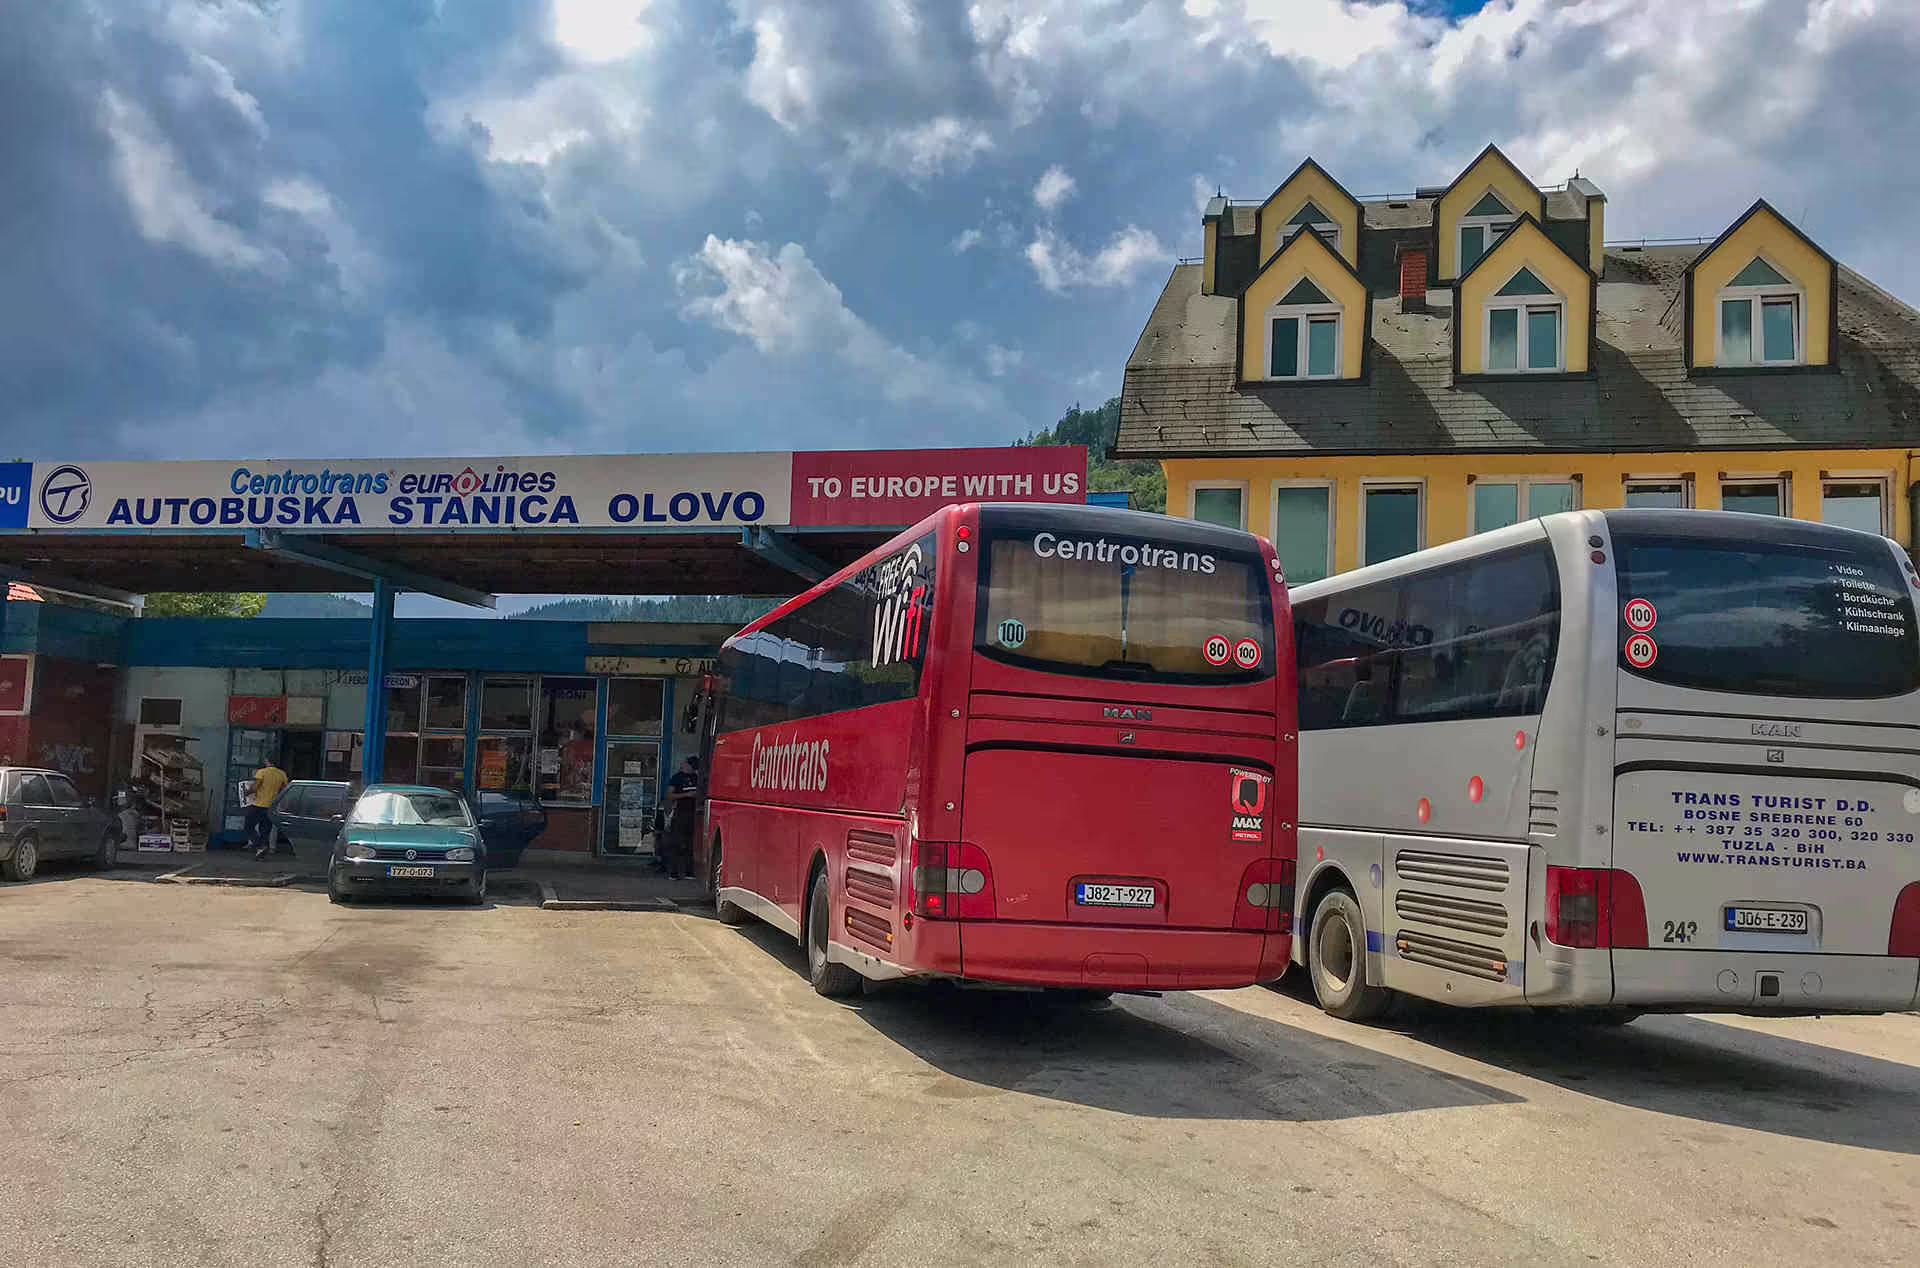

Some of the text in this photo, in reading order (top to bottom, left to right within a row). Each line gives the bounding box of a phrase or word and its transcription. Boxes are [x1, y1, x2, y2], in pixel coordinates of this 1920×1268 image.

[230, 468, 389, 496] Centrotrans
[807, 472, 1080, 498] TO EUROPE WITH US
[106, 491, 765, 525] AUTOBUSKA STANICA OLOVO
[1033, 531, 1217, 575] Centrotrans
[877, 555, 902, 600] FREE
[1836, 564, 1864, 577] Video
[1839, 577, 1876, 591] Toilette
[1843, 591, 1895, 607] Bordküche
[1630, 607, 1651, 623] 100
[1844, 605, 1905, 621] Kühlschrank
[1000, 622, 1025, 644] 100
[1846, 620, 1905, 637] Klimaanlage
[1208, 641, 1226, 658] 80
[1237, 646, 1256, 661] 100
[1632, 643, 1649, 658] 80
[1103, 706, 1153, 721] MAN
[751, 729, 830, 792] Centrotrans
[1671, 791, 1876, 813] TRANS TURIST D.D.
[1232, 816, 1263, 830] MAX
[1684, 809, 1864, 827] BOSNE SREBRENE 60
[1628, 821, 1665, 833] TEL:
[1705, 825, 1736, 836] 387
[1744, 826, 1763, 837] 35
[1771, 827, 1801, 839] 320
[1808, 829, 1843, 842] 300,
[1850, 831, 1879, 842] 320
[1886, 832, 1914, 843] 330
[1722, 840, 1776, 852] TUZLA
[1797, 843, 1826, 854] BiH
[1677, 852, 1867, 870] WWW.TRANSTURIST.BA
[1086, 887, 1152, 902] J82-T-927
